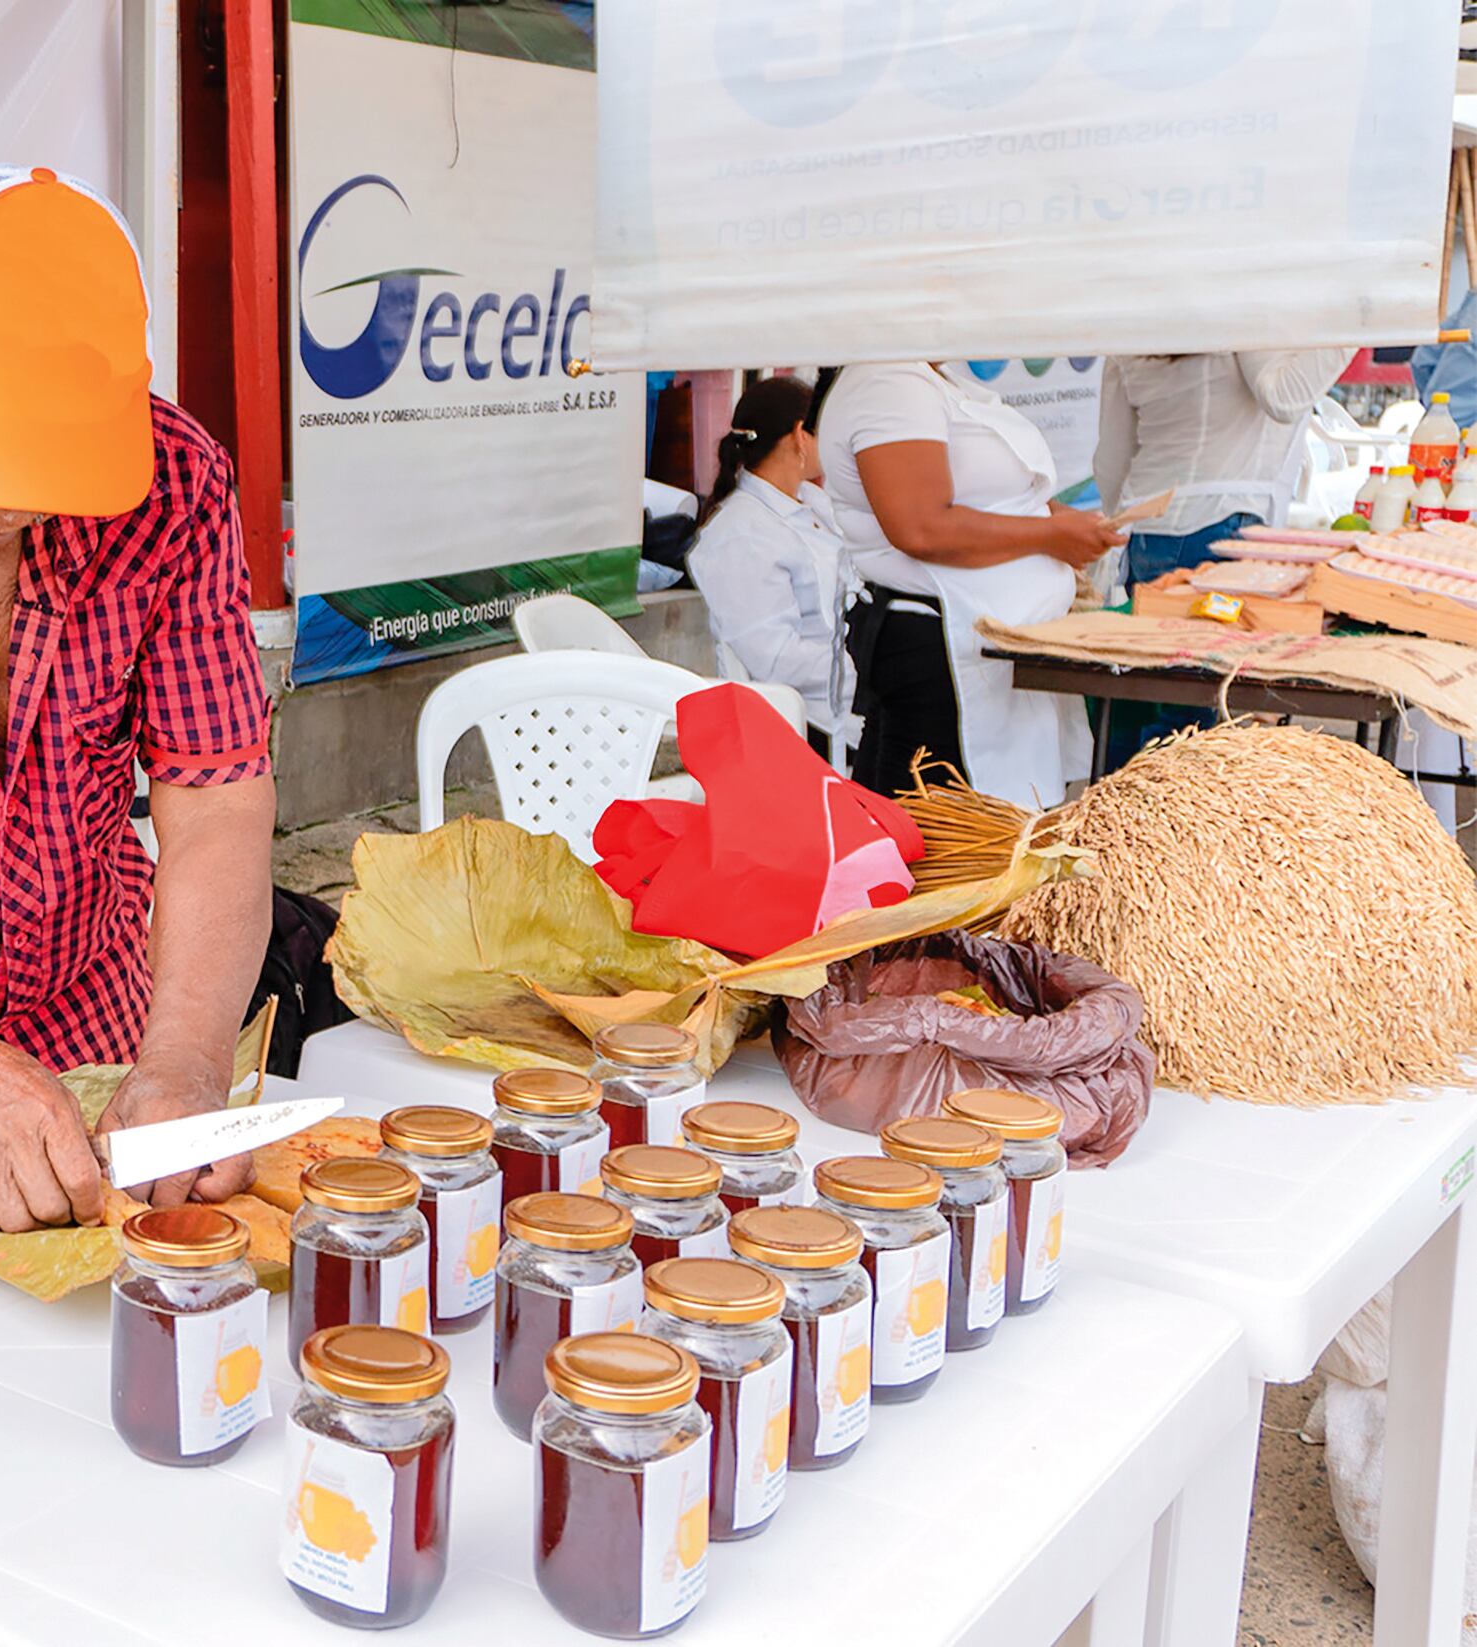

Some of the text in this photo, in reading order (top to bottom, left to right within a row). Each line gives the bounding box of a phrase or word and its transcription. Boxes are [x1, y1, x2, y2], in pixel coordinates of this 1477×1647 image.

[299, 174, 604, 399] Gecelc
[299, 411, 370, 427] GENERADORA
[373, 411, 381, 423] Y
[381, 406, 469, 423] COMERCIALIZADORA
[470, 406, 481, 418] DE
[517, 403, 531, 415] DEL
[533, 400, 560, 414] CARIBE
[563, 392, 584, 411] S.A.
[588, 390, 617, 409] E.S.P.
[369, 609, 429, 646] ¡Energía
[432, 609, 460, 634] que
